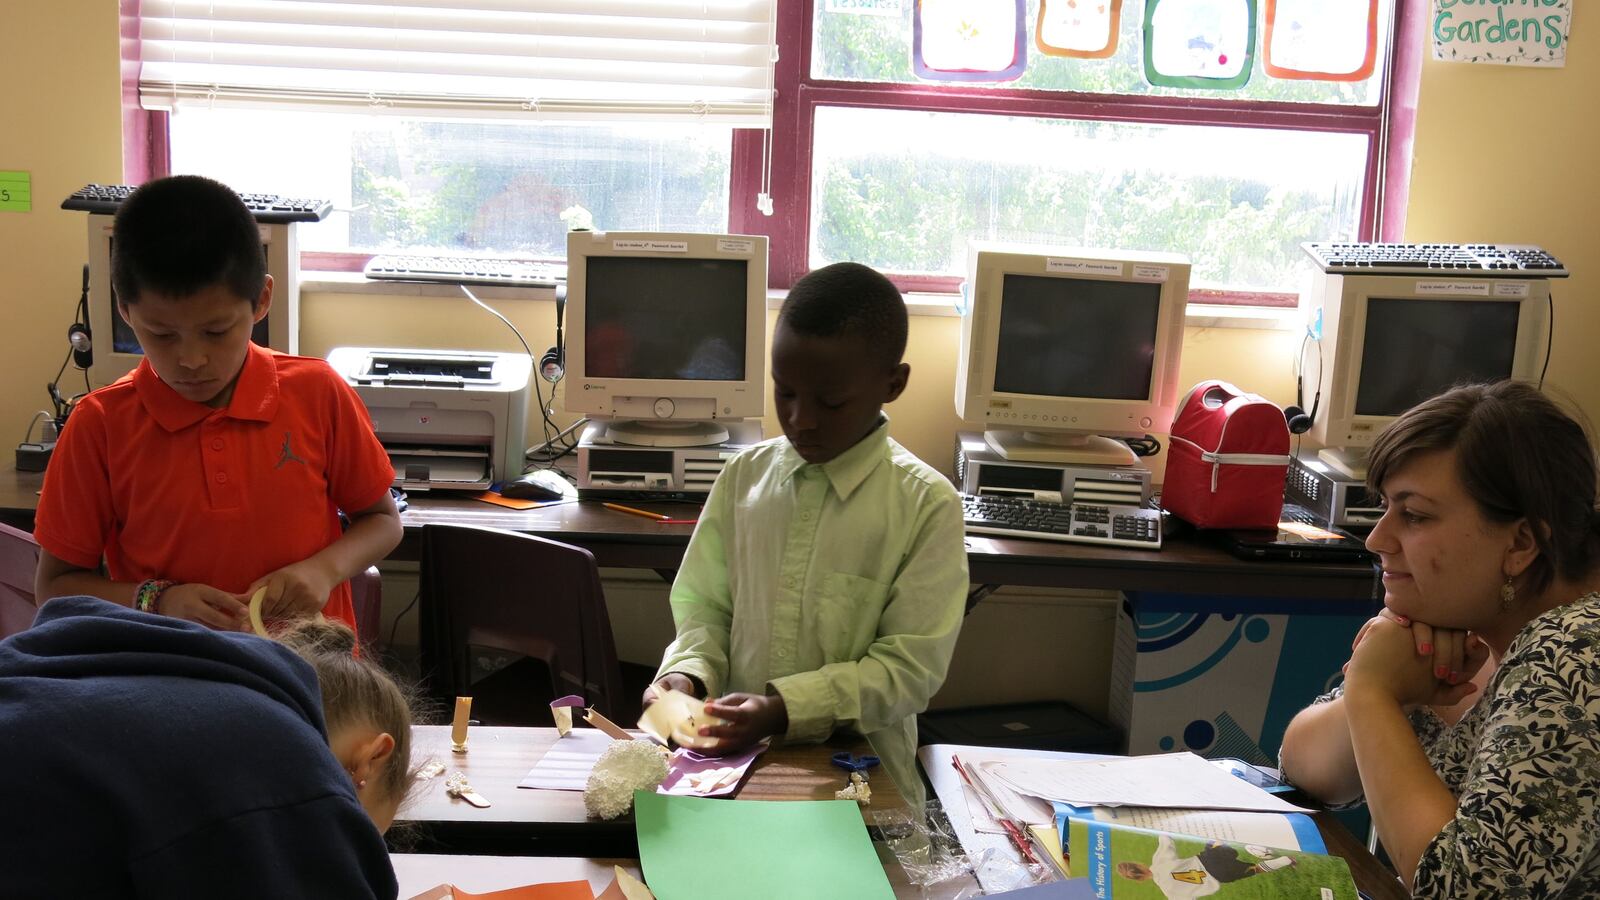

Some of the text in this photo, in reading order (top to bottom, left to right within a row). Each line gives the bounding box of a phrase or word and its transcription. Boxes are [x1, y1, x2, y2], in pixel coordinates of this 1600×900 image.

[1434, 6, 1562, 49] Gardens
[1094, 831, 1107, 899] The History of Sports
[1171, 869, 1207, 885] 4
